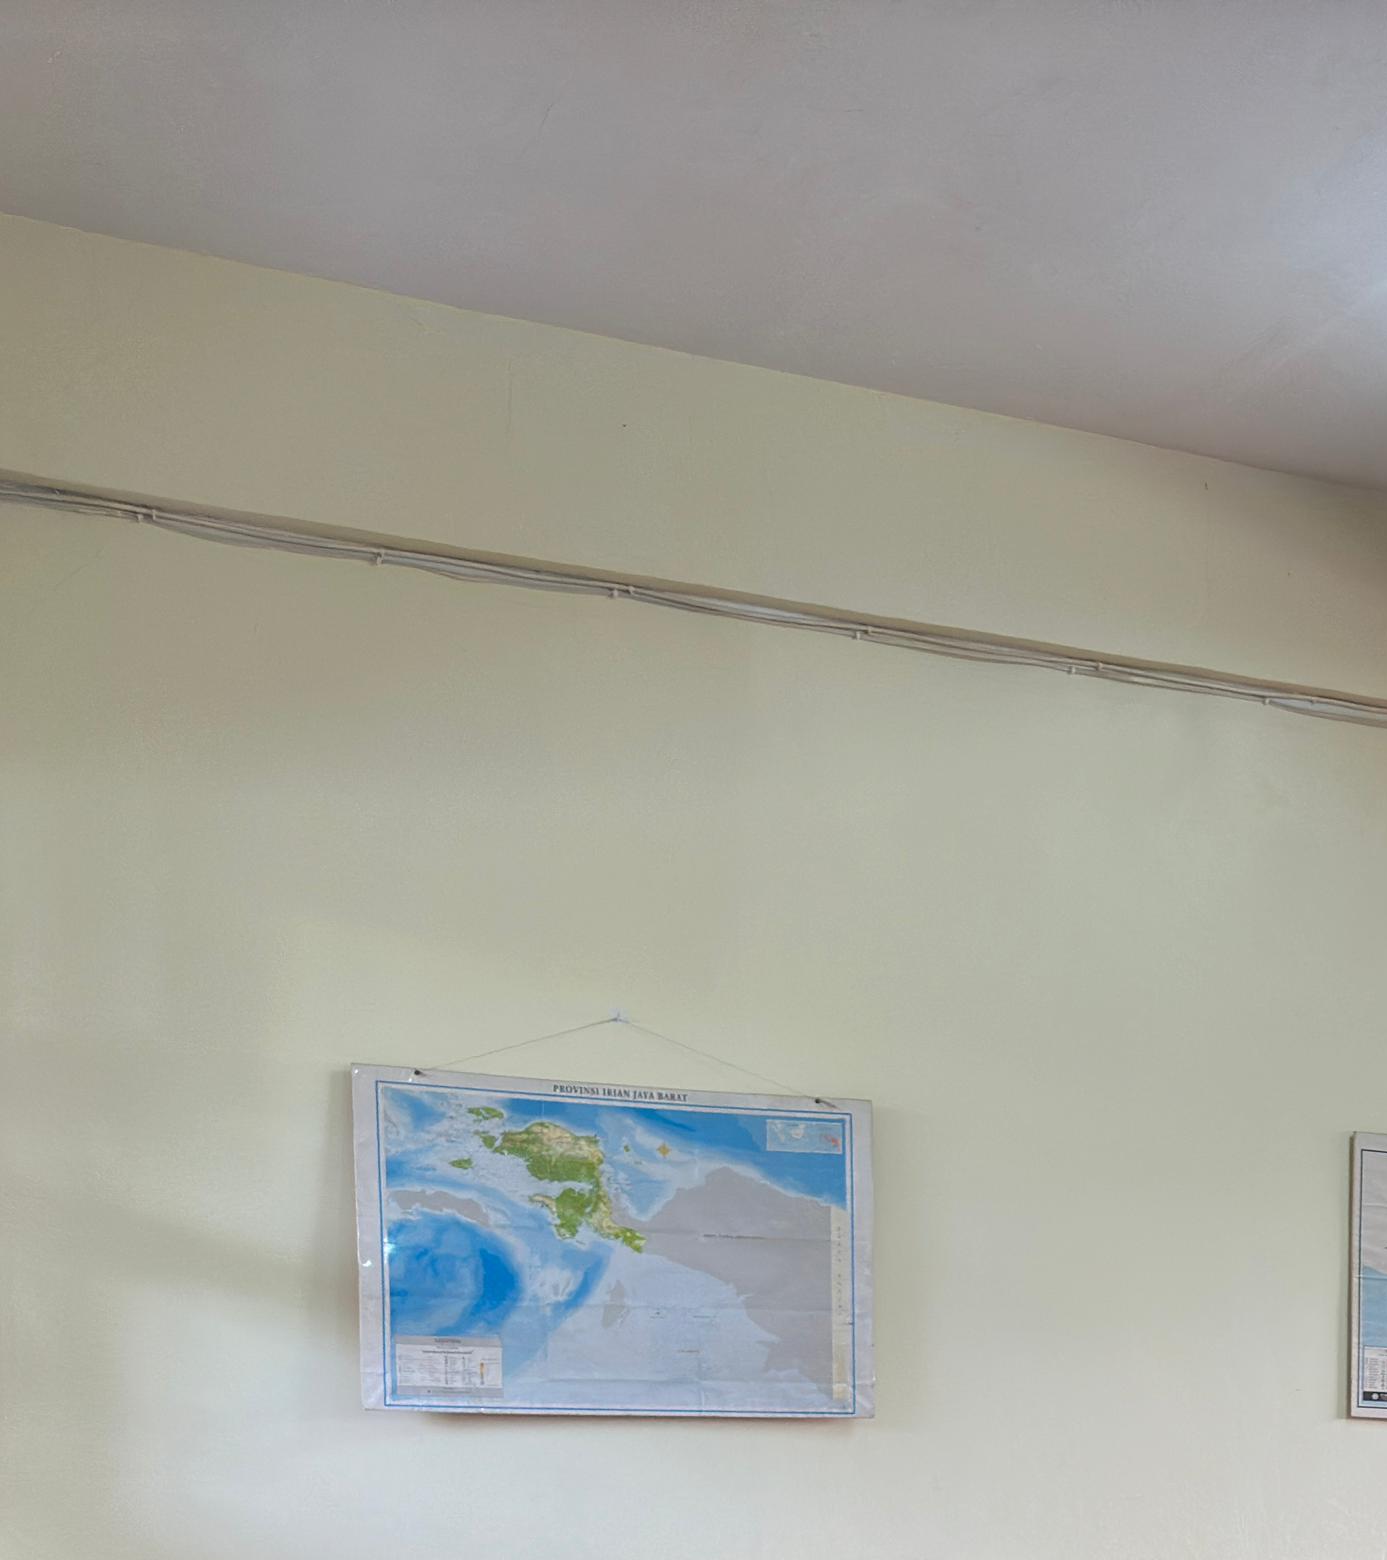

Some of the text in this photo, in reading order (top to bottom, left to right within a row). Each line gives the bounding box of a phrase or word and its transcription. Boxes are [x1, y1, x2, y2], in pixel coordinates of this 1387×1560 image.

[553, 1084, 688, 1102] PROVINSI IRIAN JAYA BARAT
